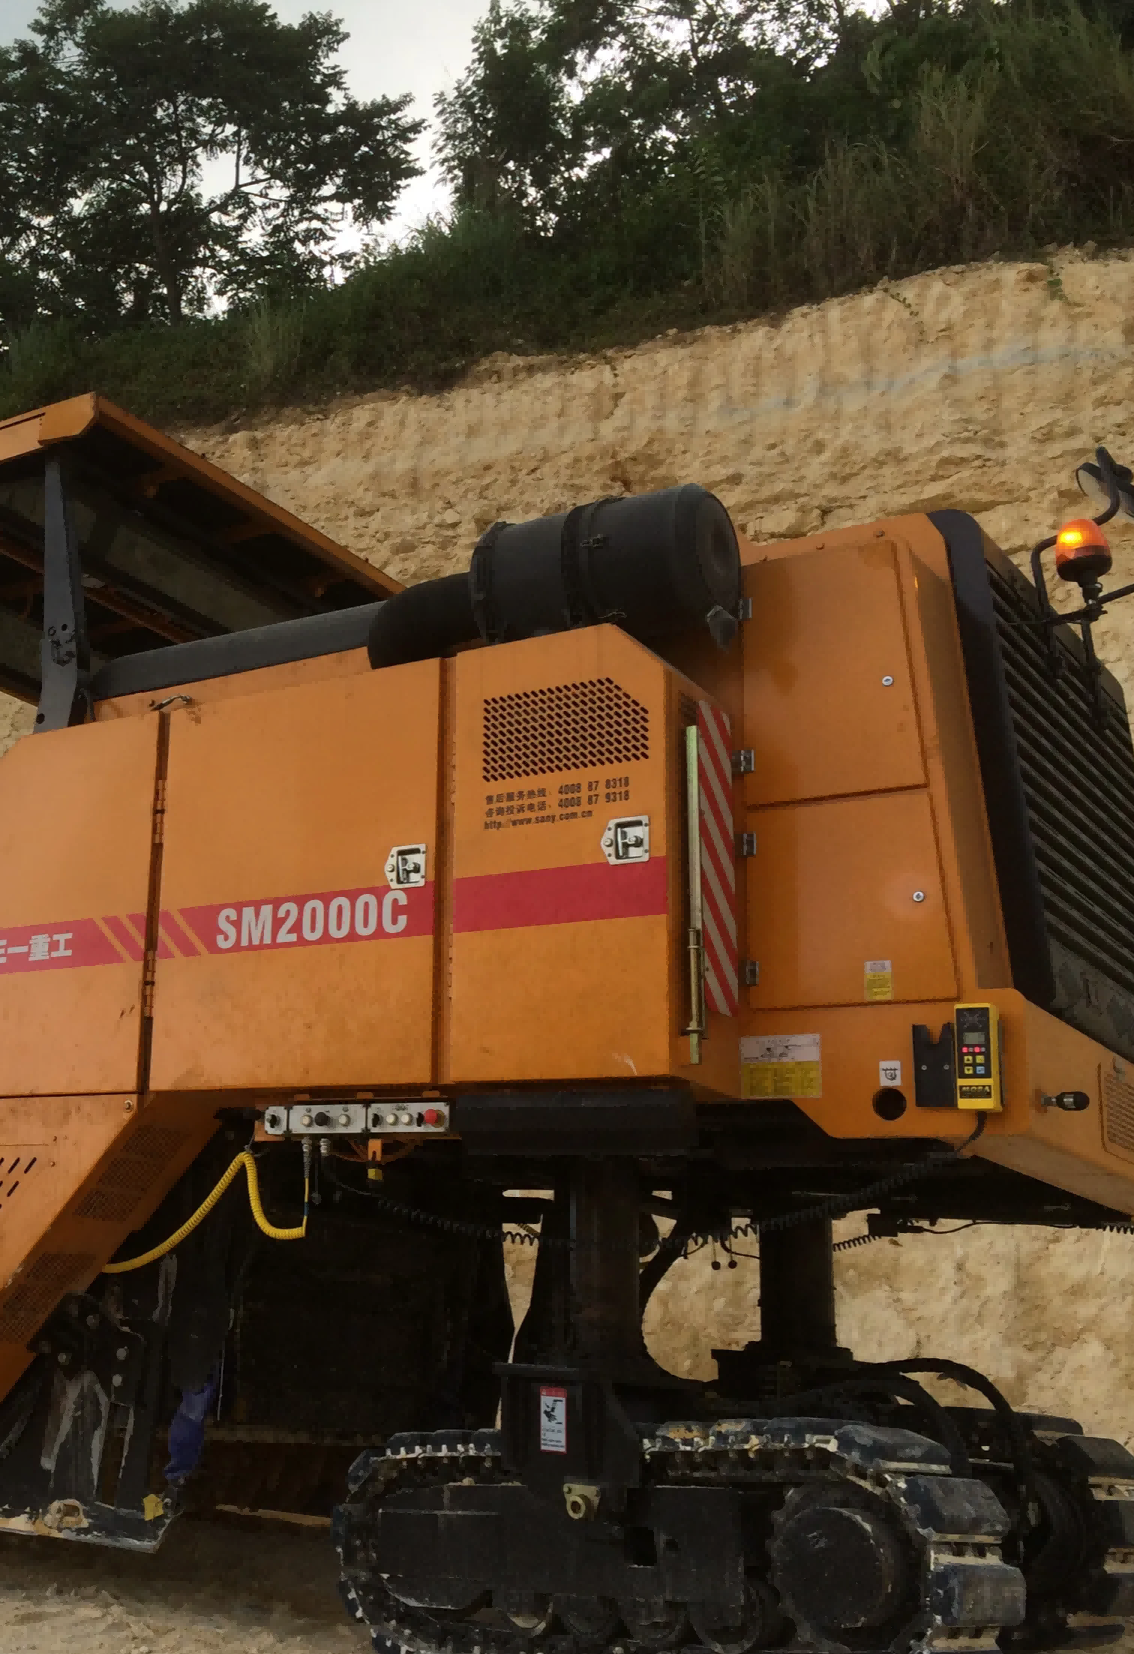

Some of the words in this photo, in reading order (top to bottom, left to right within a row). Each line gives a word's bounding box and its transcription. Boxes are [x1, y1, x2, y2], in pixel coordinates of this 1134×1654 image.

[558, 783, 582, 795] 4008
[587, 780, 600, 792] 87
[605, 776, 630, 789] 8318
[558, 796, 582, 808] 4008
[587, 794, 600, 805] 87
[605, 790, 630, 803] 9318
[216, 889, 408, 949] SM2000C
